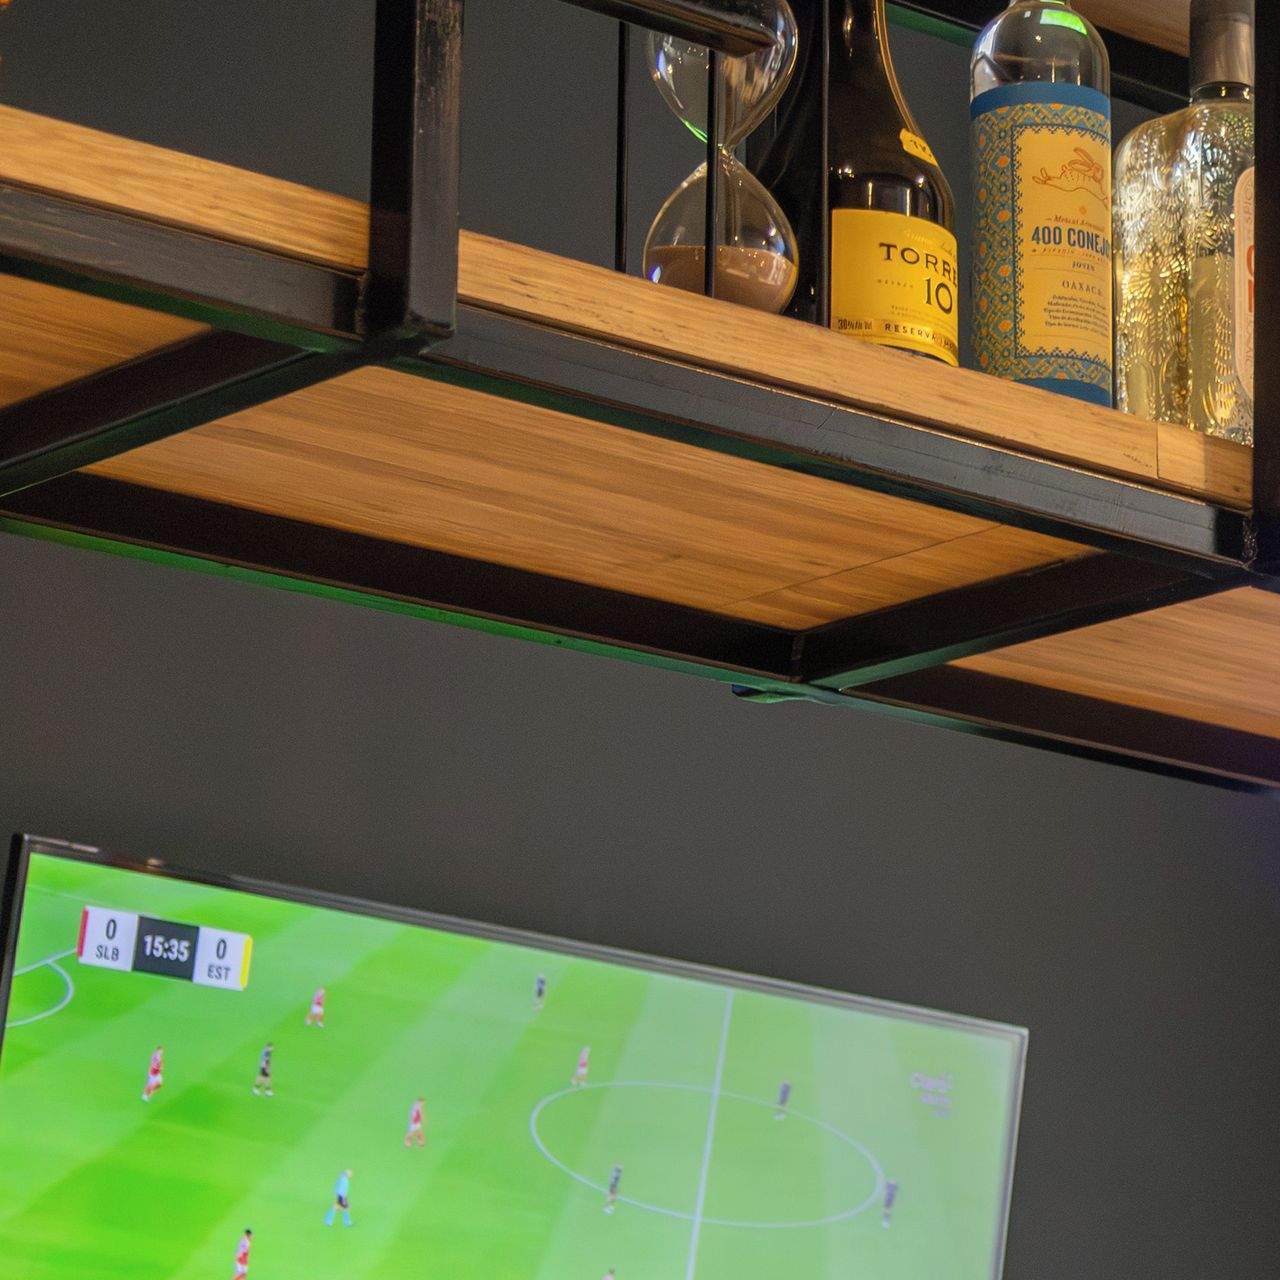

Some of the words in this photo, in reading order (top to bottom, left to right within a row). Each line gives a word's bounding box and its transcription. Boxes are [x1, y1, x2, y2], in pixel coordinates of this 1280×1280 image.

[1031, 225, 1063, 246] 400
[922, 276, 954, 315] 10
[884, 322, 938, 341] RESERVA
[105, 918, 118, 941] 0
[143, 934, 192, 963] 15:35
[215, 938, 228, 961] 0
[95, 944, 120, 962] SLB
[207, 964, 232, 982] EST
